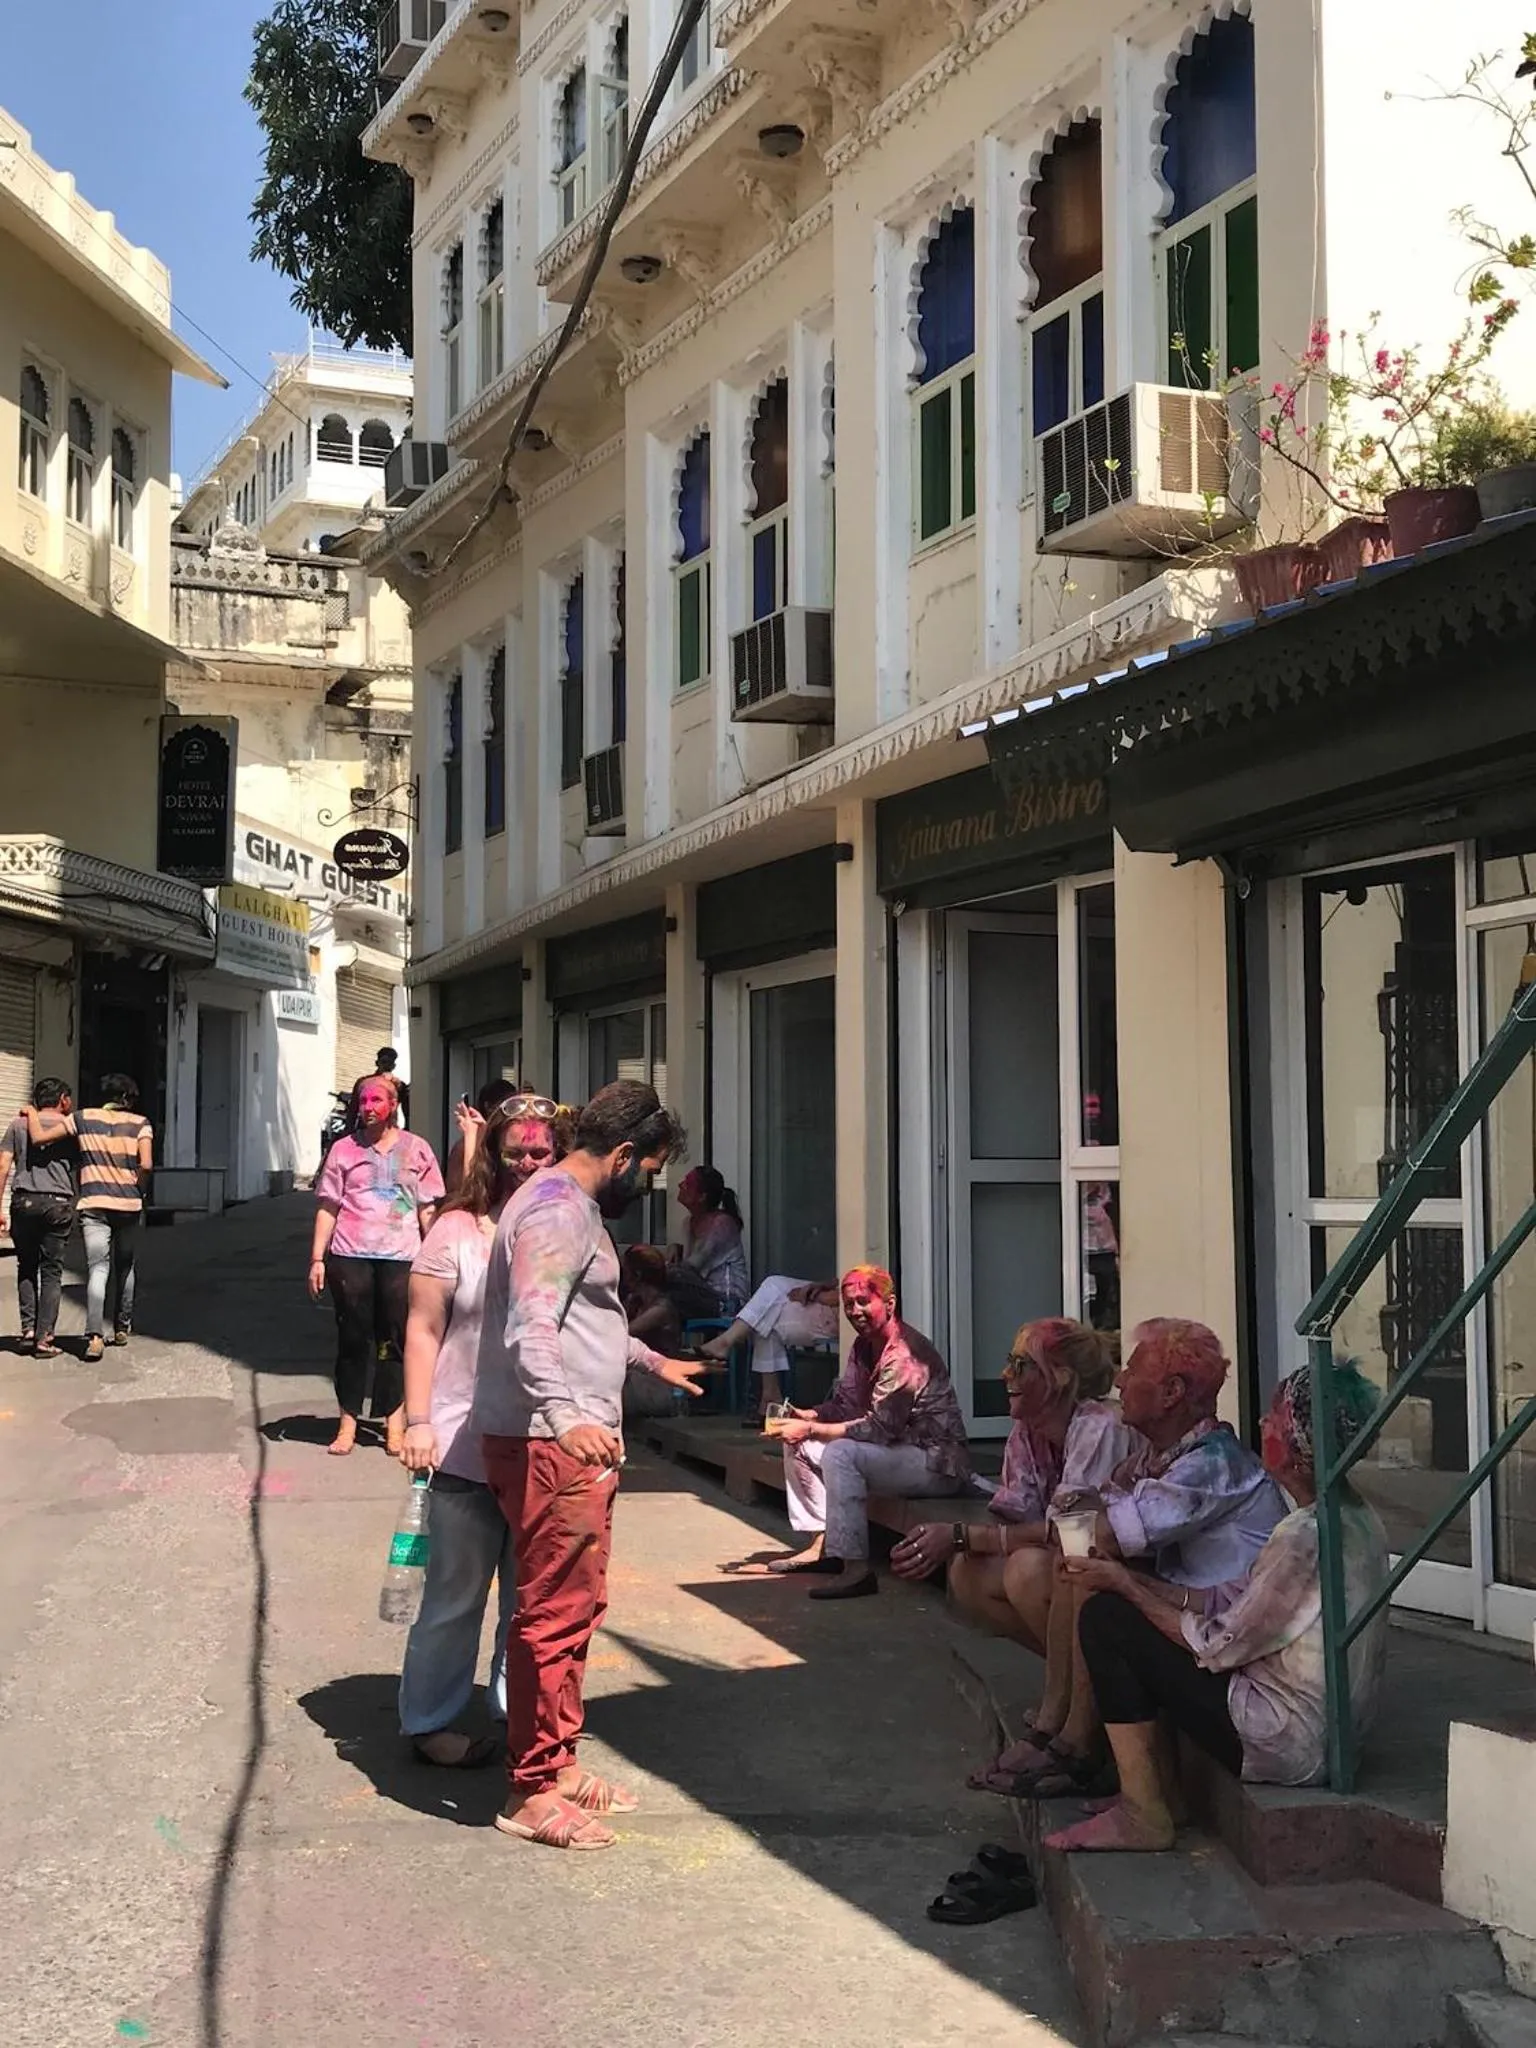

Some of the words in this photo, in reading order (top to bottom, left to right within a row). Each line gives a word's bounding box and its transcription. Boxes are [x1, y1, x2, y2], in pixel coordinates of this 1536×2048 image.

[890, 810, 998, 878] Jaiwana
[1005, 778, 1104, 837] Bistro
[246, 832, 313, 880] GHAT
[321, 862, 391, 910] GUEST
[222, 912, 265, 938] GUEST
[268, 926, 308, 951] HOUSE
[234, 891, 298, 929] LALGHAT
